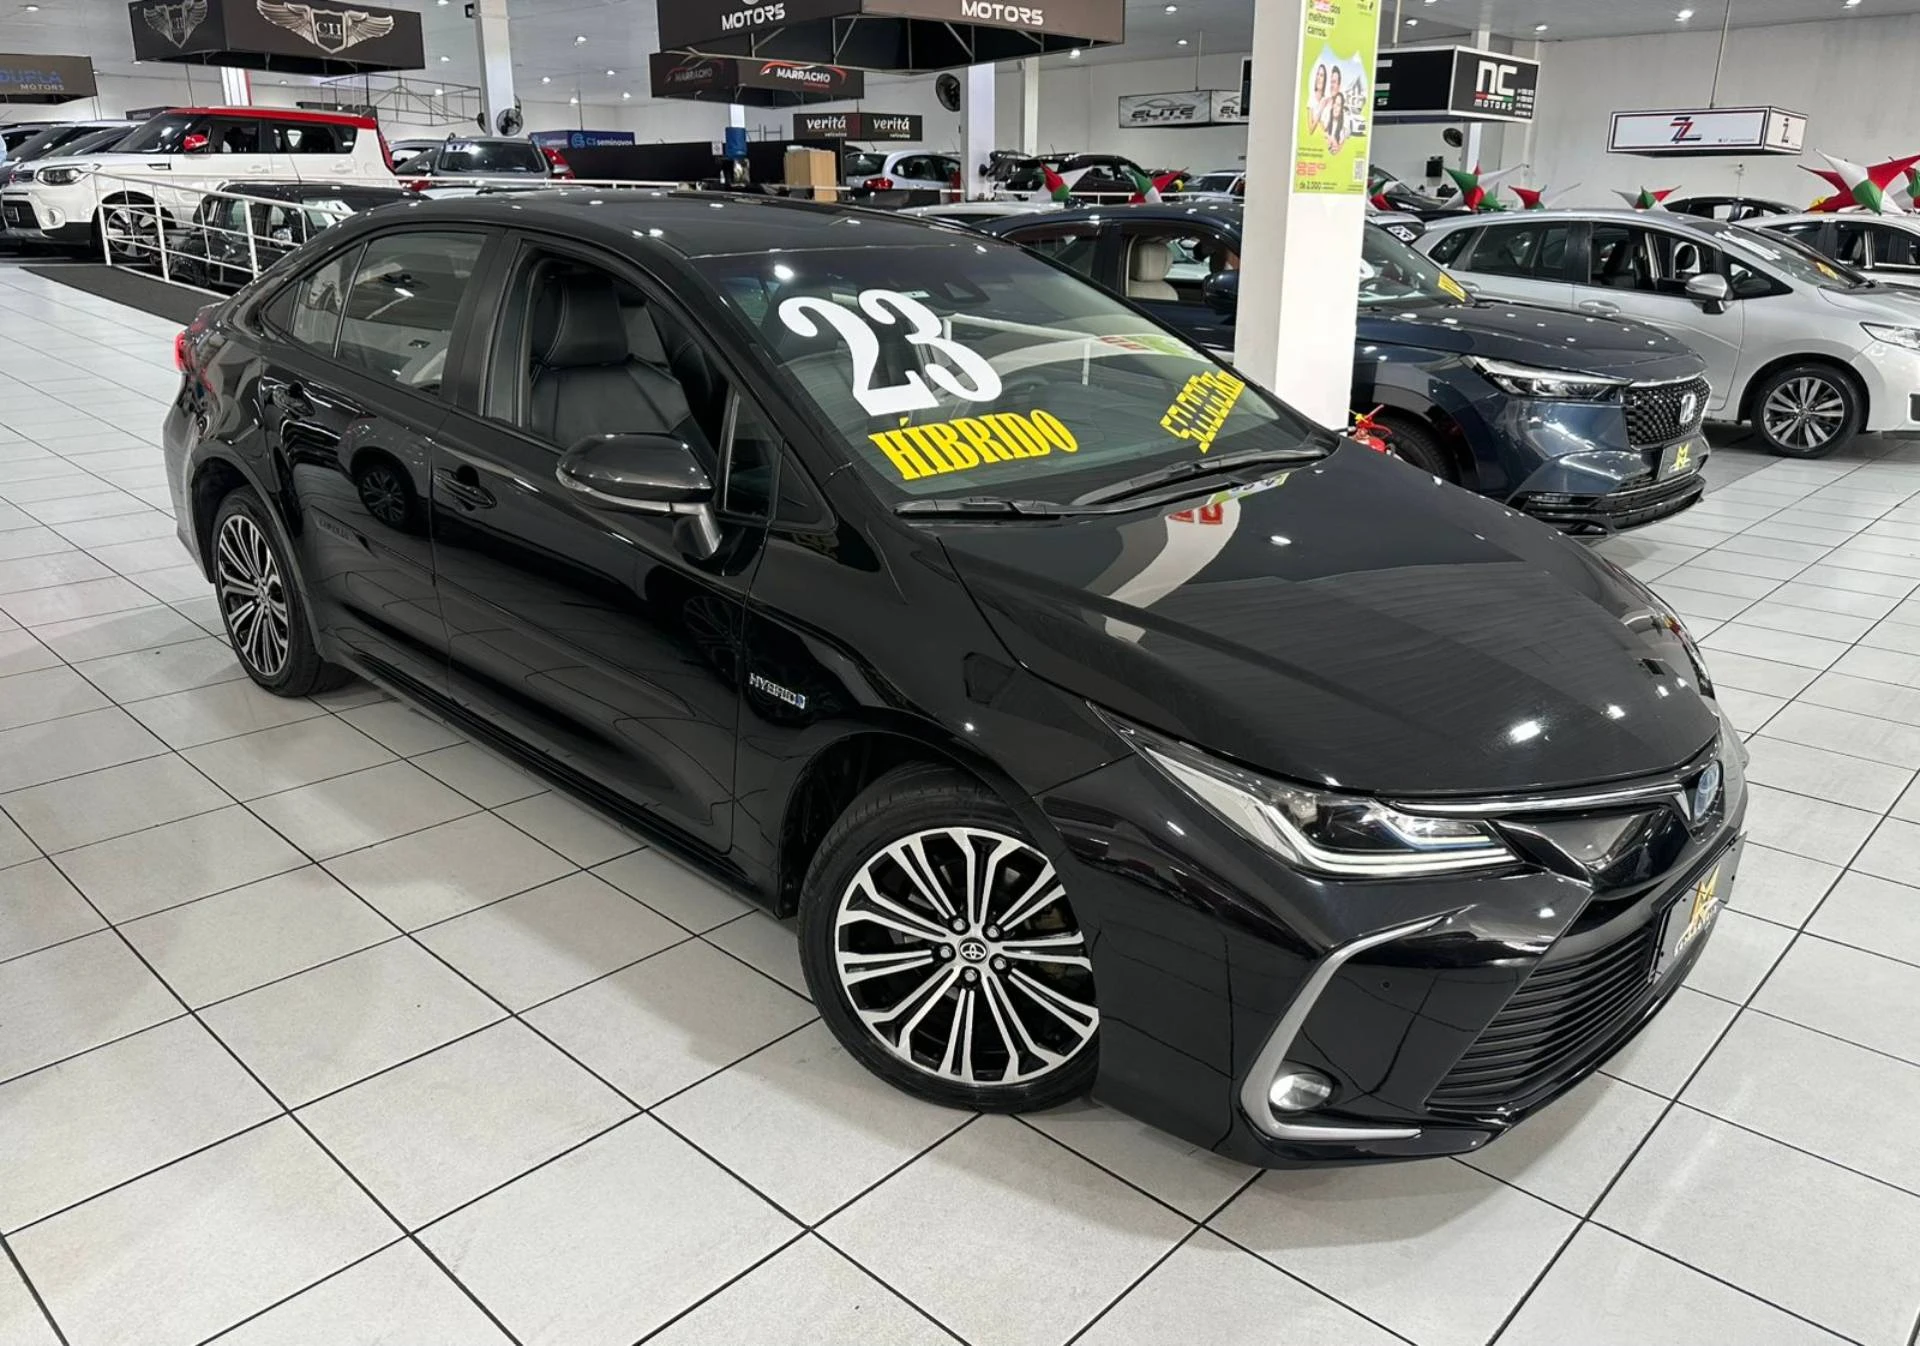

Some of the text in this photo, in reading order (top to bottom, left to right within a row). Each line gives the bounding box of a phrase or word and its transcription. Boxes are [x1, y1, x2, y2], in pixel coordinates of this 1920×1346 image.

[722, 3, 786, 31] MOTORS
[961, 0, 1044, 26] MOTORS
[20, 83, 65, 91] MOTORS
[776, 67, 831, 83] MARRACHO
[1132, 106, 1196, 118] ELITE
[1474, 98, 1513, 111] MOTORS
[777, 288, 1003, 417] 23
[867, 407, 1079, 481] HÍBRIDO
[748, 672, 806, 709] HYBRID
